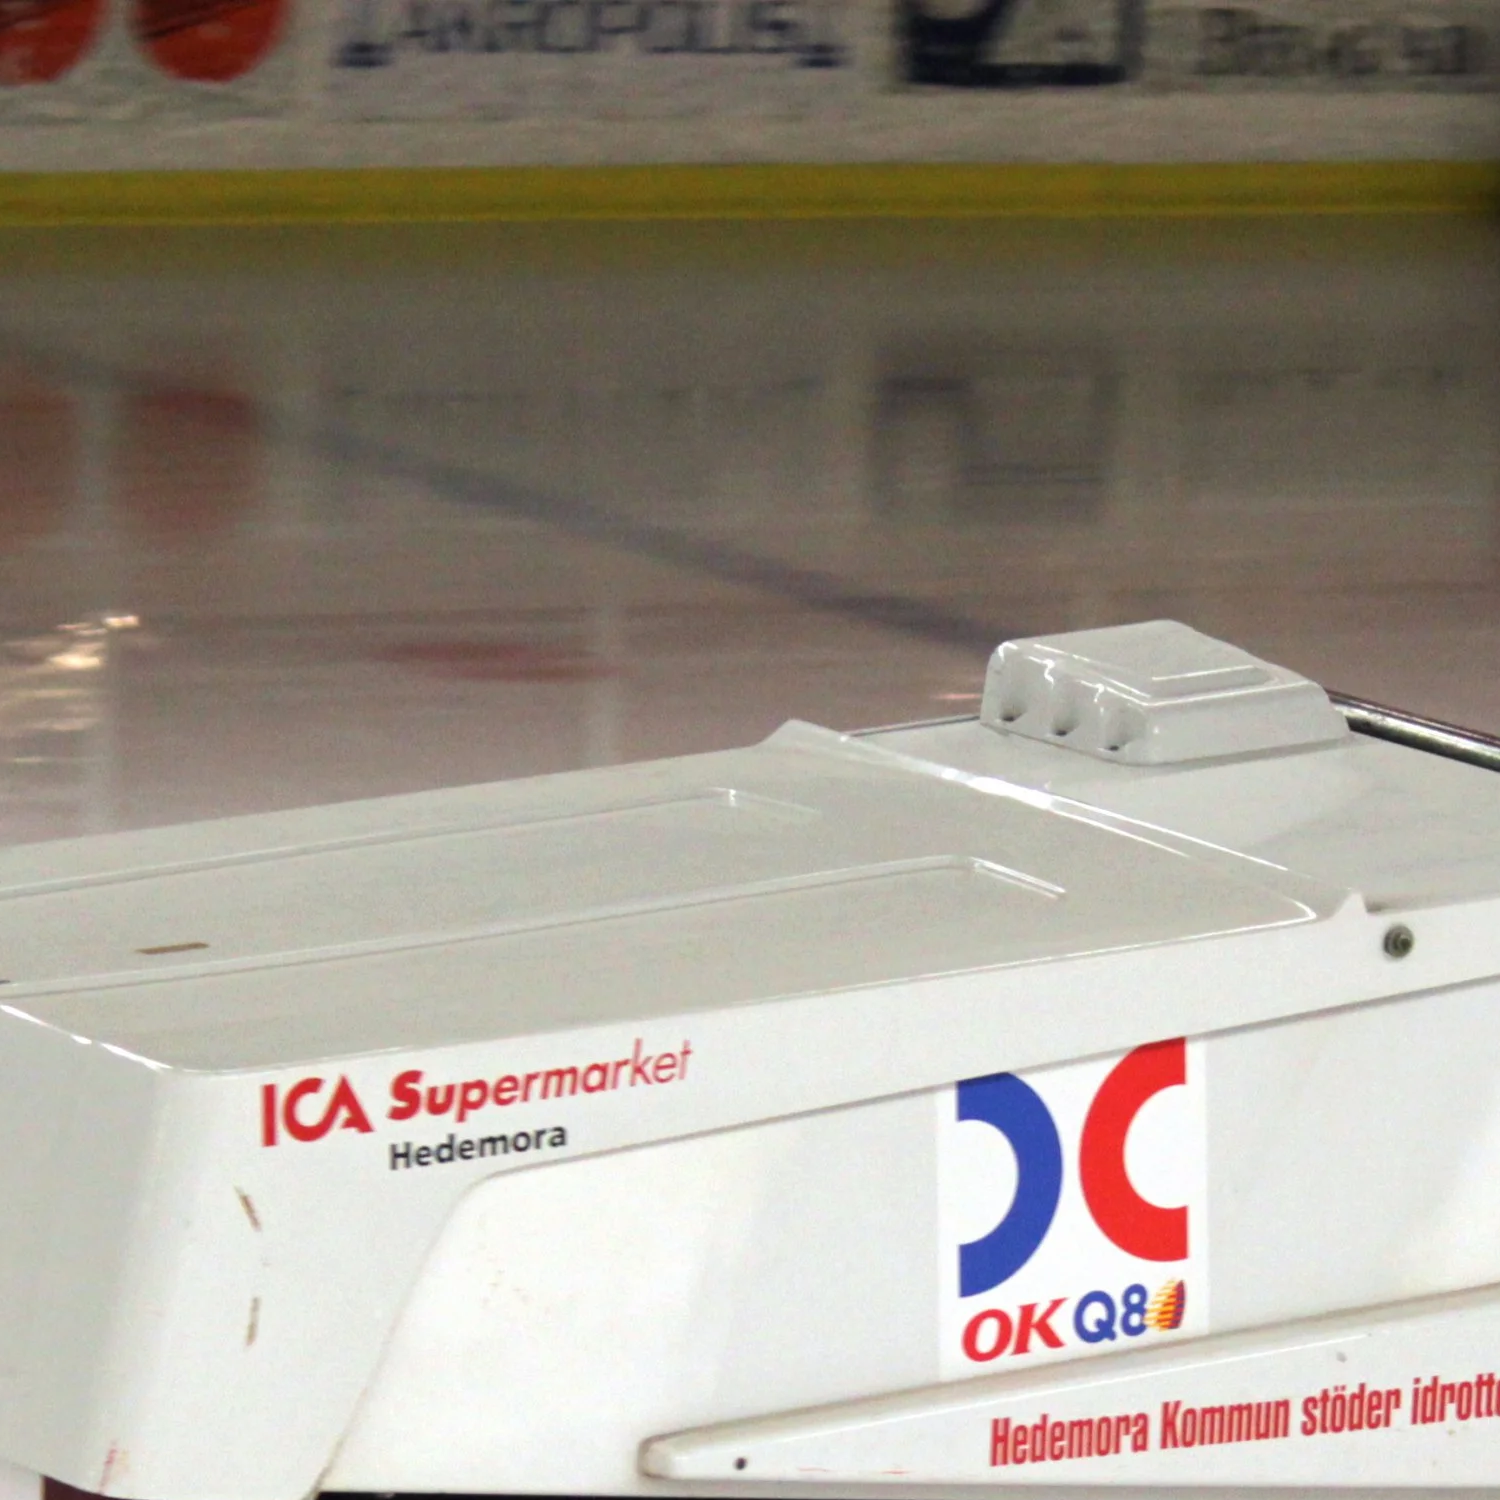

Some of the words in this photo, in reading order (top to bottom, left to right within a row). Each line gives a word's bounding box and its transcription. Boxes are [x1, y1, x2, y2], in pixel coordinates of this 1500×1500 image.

[260, 1074, 374, 1147] ICA
[387, 1038, 693, 1122] Supermarket
[389, 1124, 568, 1170] Hedemora
[961, 1297, 1066, 1362] OK
[1074, 1283, 1148, 1344] Q8
[989, 1412, 1148, 1467] Hedemora
[1160, 1396, 1290, 1449] Kommun
[1302, 1384, 1401, 1432] stöder
